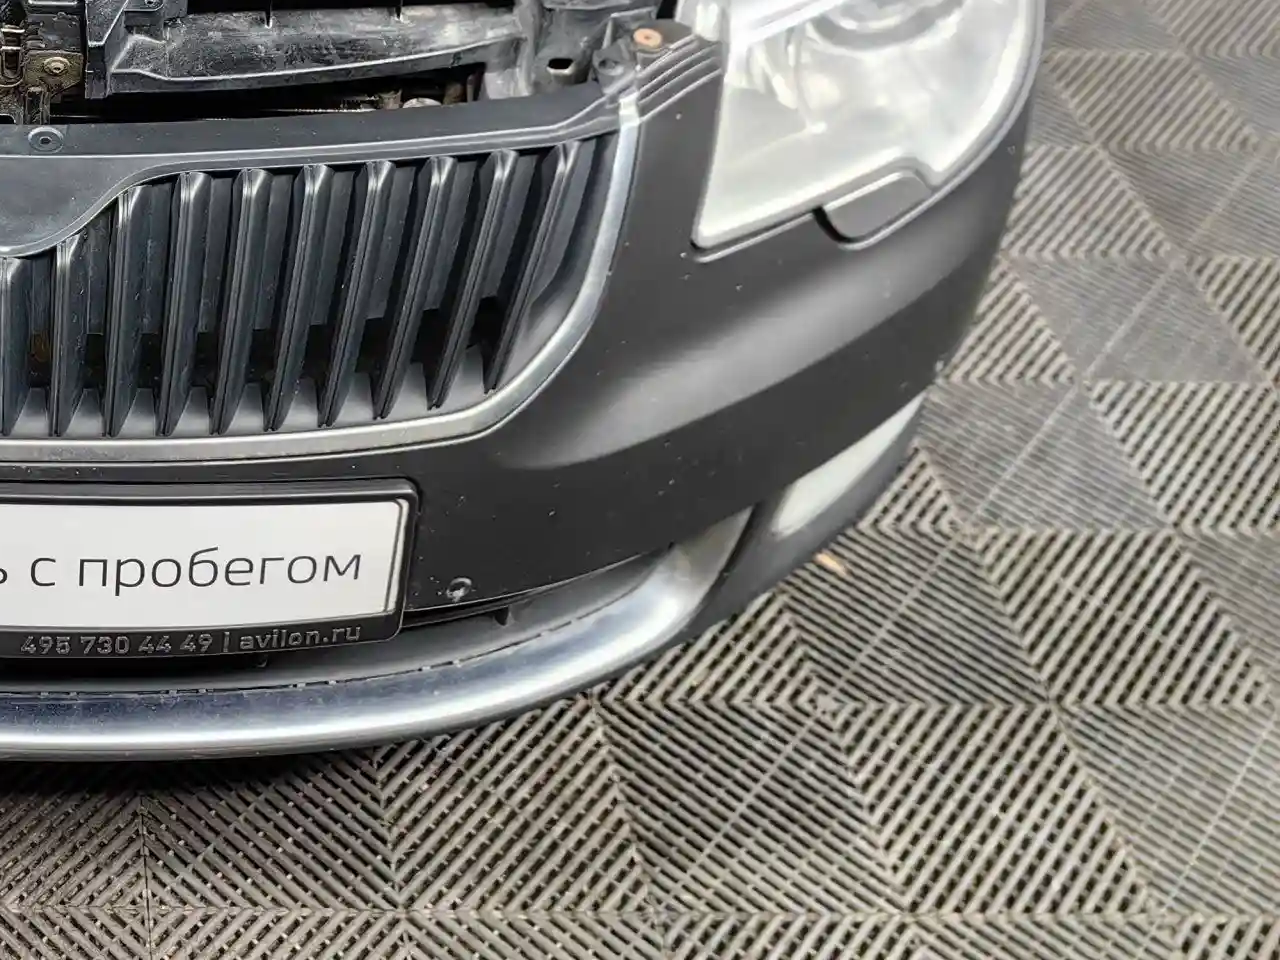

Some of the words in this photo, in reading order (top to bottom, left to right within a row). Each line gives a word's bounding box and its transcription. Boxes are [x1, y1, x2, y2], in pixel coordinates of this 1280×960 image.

[77, 546, 363, 597] пробегом
[20, 635, 71, 655] 495
[79, 635, 131, 655] 730
[138, 635, 172, 654] 44
[179, 633, 213, 653] 49
[239, 626, 362, 650] avilon.ru
